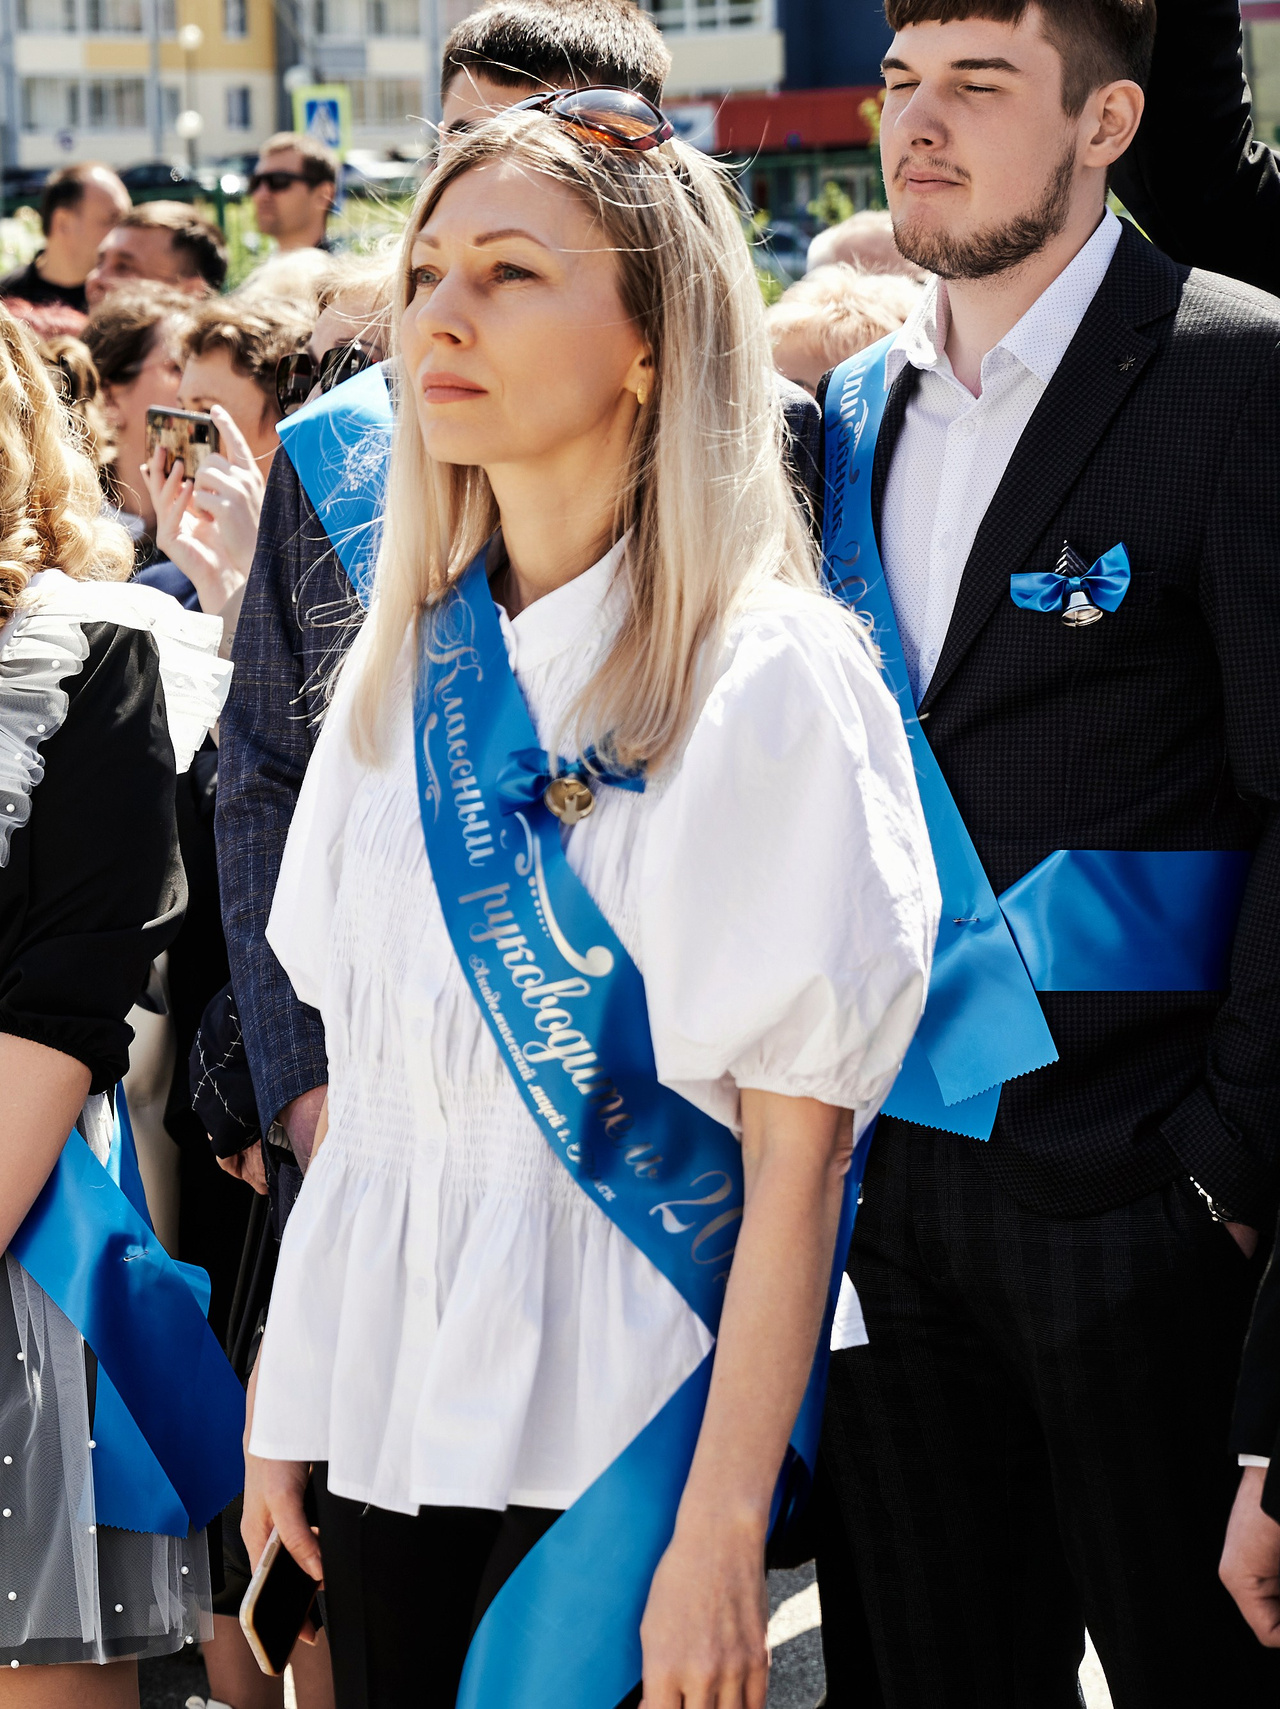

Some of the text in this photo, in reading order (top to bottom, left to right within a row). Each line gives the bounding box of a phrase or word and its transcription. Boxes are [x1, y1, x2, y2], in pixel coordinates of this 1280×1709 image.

[426, 594, 508, 867] Классный
[468, 954, 538, 1082] Академический
[527, 1083, 568, 1129] лицей
